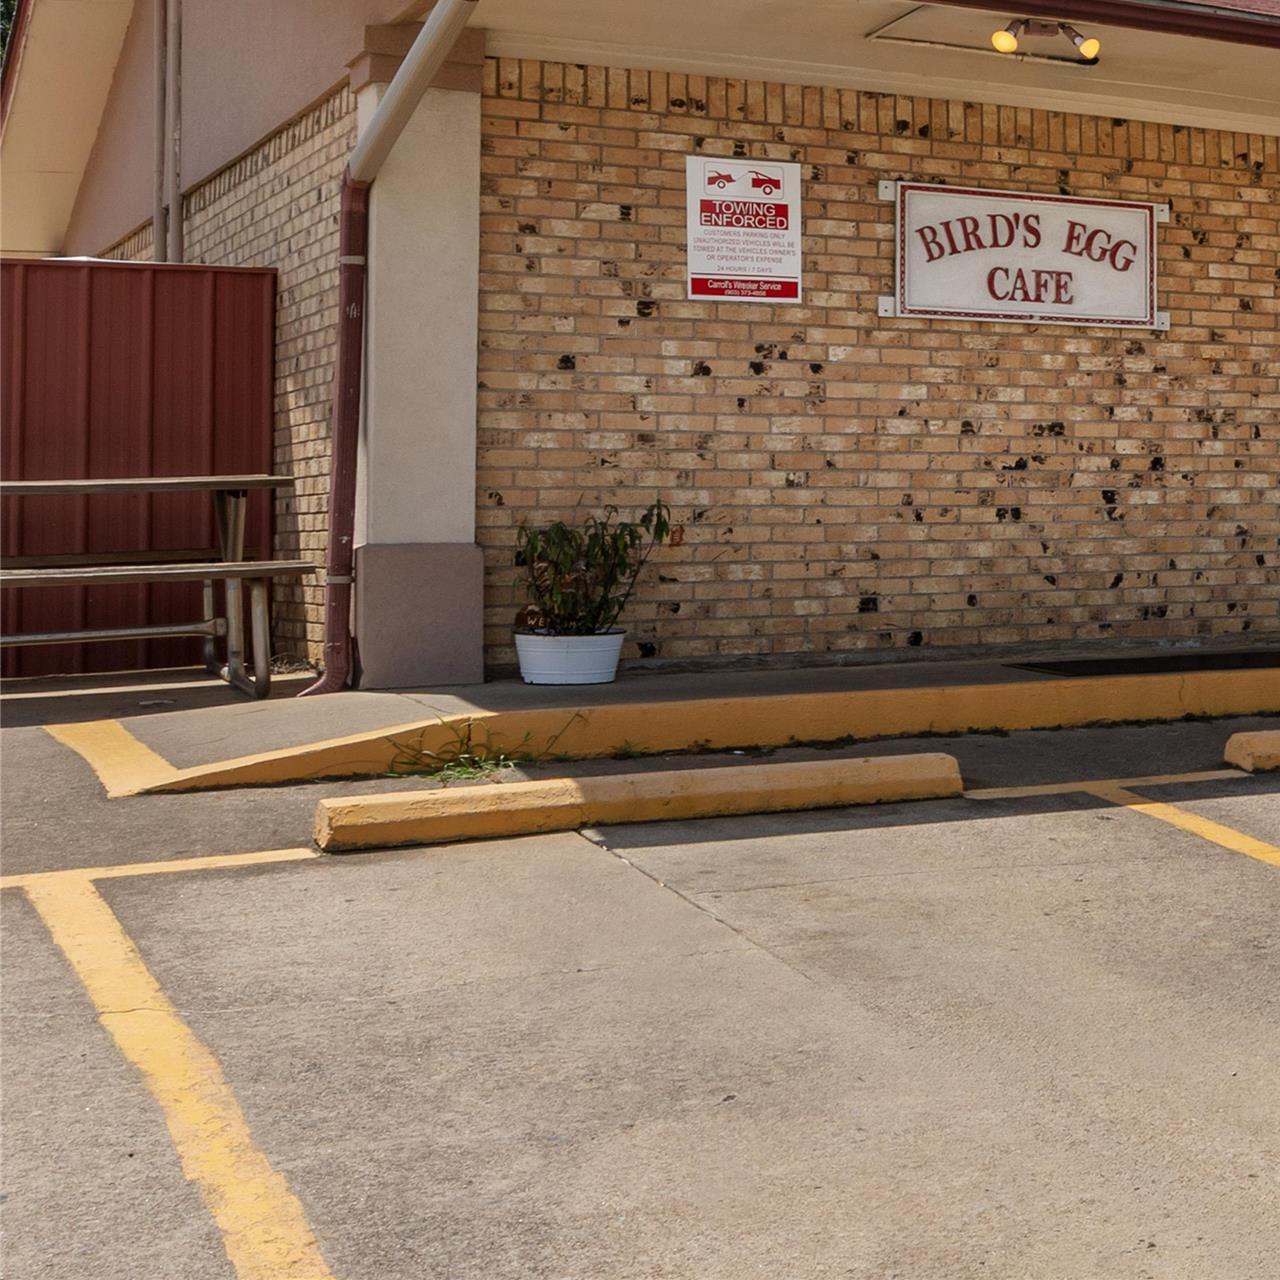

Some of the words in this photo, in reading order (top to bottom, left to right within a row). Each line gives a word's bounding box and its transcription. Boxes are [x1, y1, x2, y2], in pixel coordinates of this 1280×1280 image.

[712, 200, 776, 215] TOWING
[700, 212, 788, 229] ENFORCED
[703, 229, 741, 237] CUSTOMERS
[693, 237, 741, 245] UNAUTHORIZED
[915, 212, 1043, 263] BIRD'S
[1062, 220, 1138, 273] EGG
[693, 245, 715, 253] TOWED
[755, 256, 783, 264] EXPENSE
[759, 281, 782, 290] Service
[986, 266, 1075, 305] CAFE
